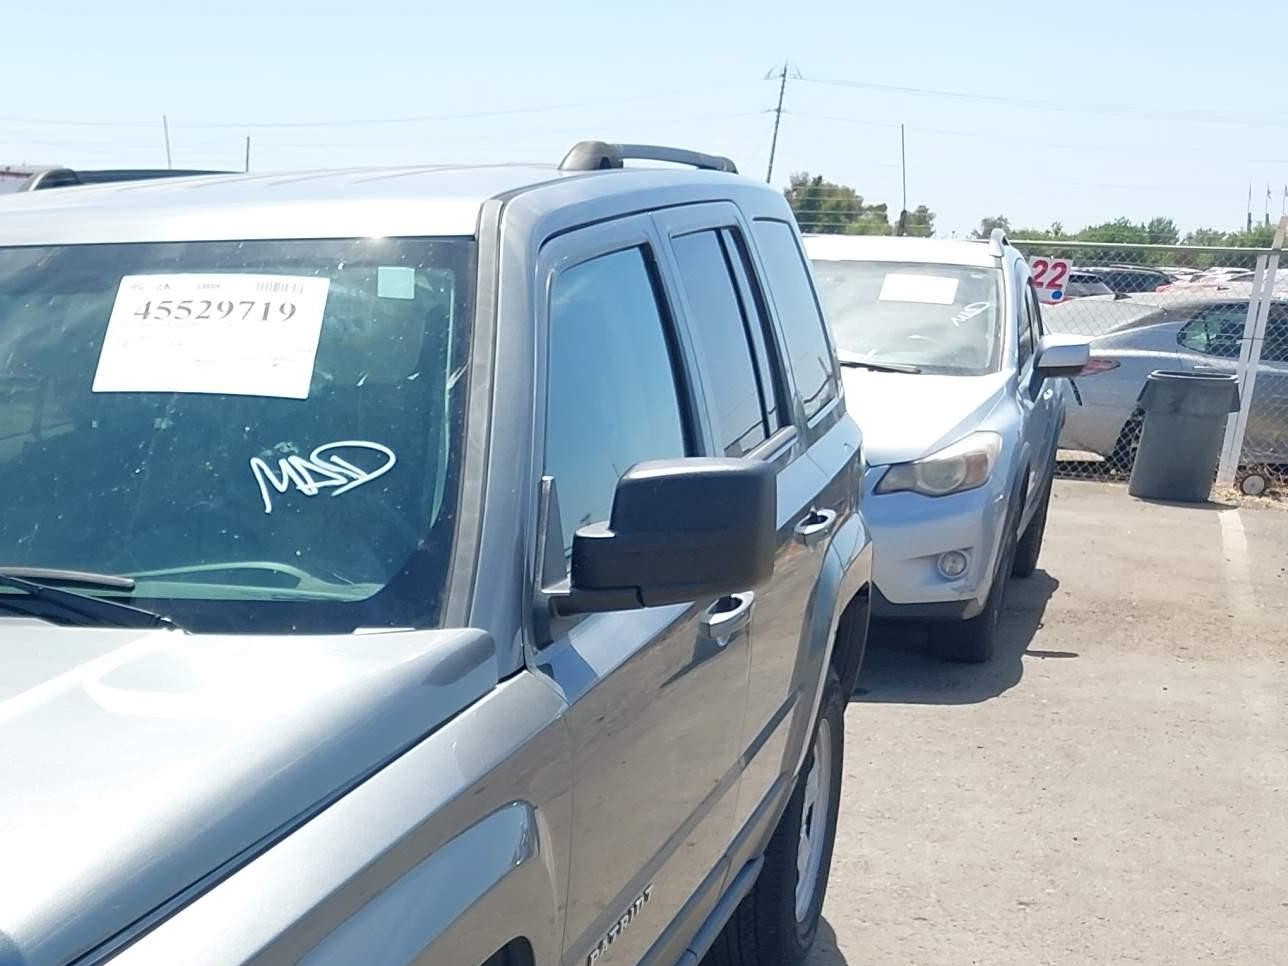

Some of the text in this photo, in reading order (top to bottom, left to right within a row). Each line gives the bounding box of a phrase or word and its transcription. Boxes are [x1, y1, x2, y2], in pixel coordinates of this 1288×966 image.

[1031, 259, 1067, 289] 22
[134, 299, 297, 322] 45529719
[250, 440, 396, 513] MAD
